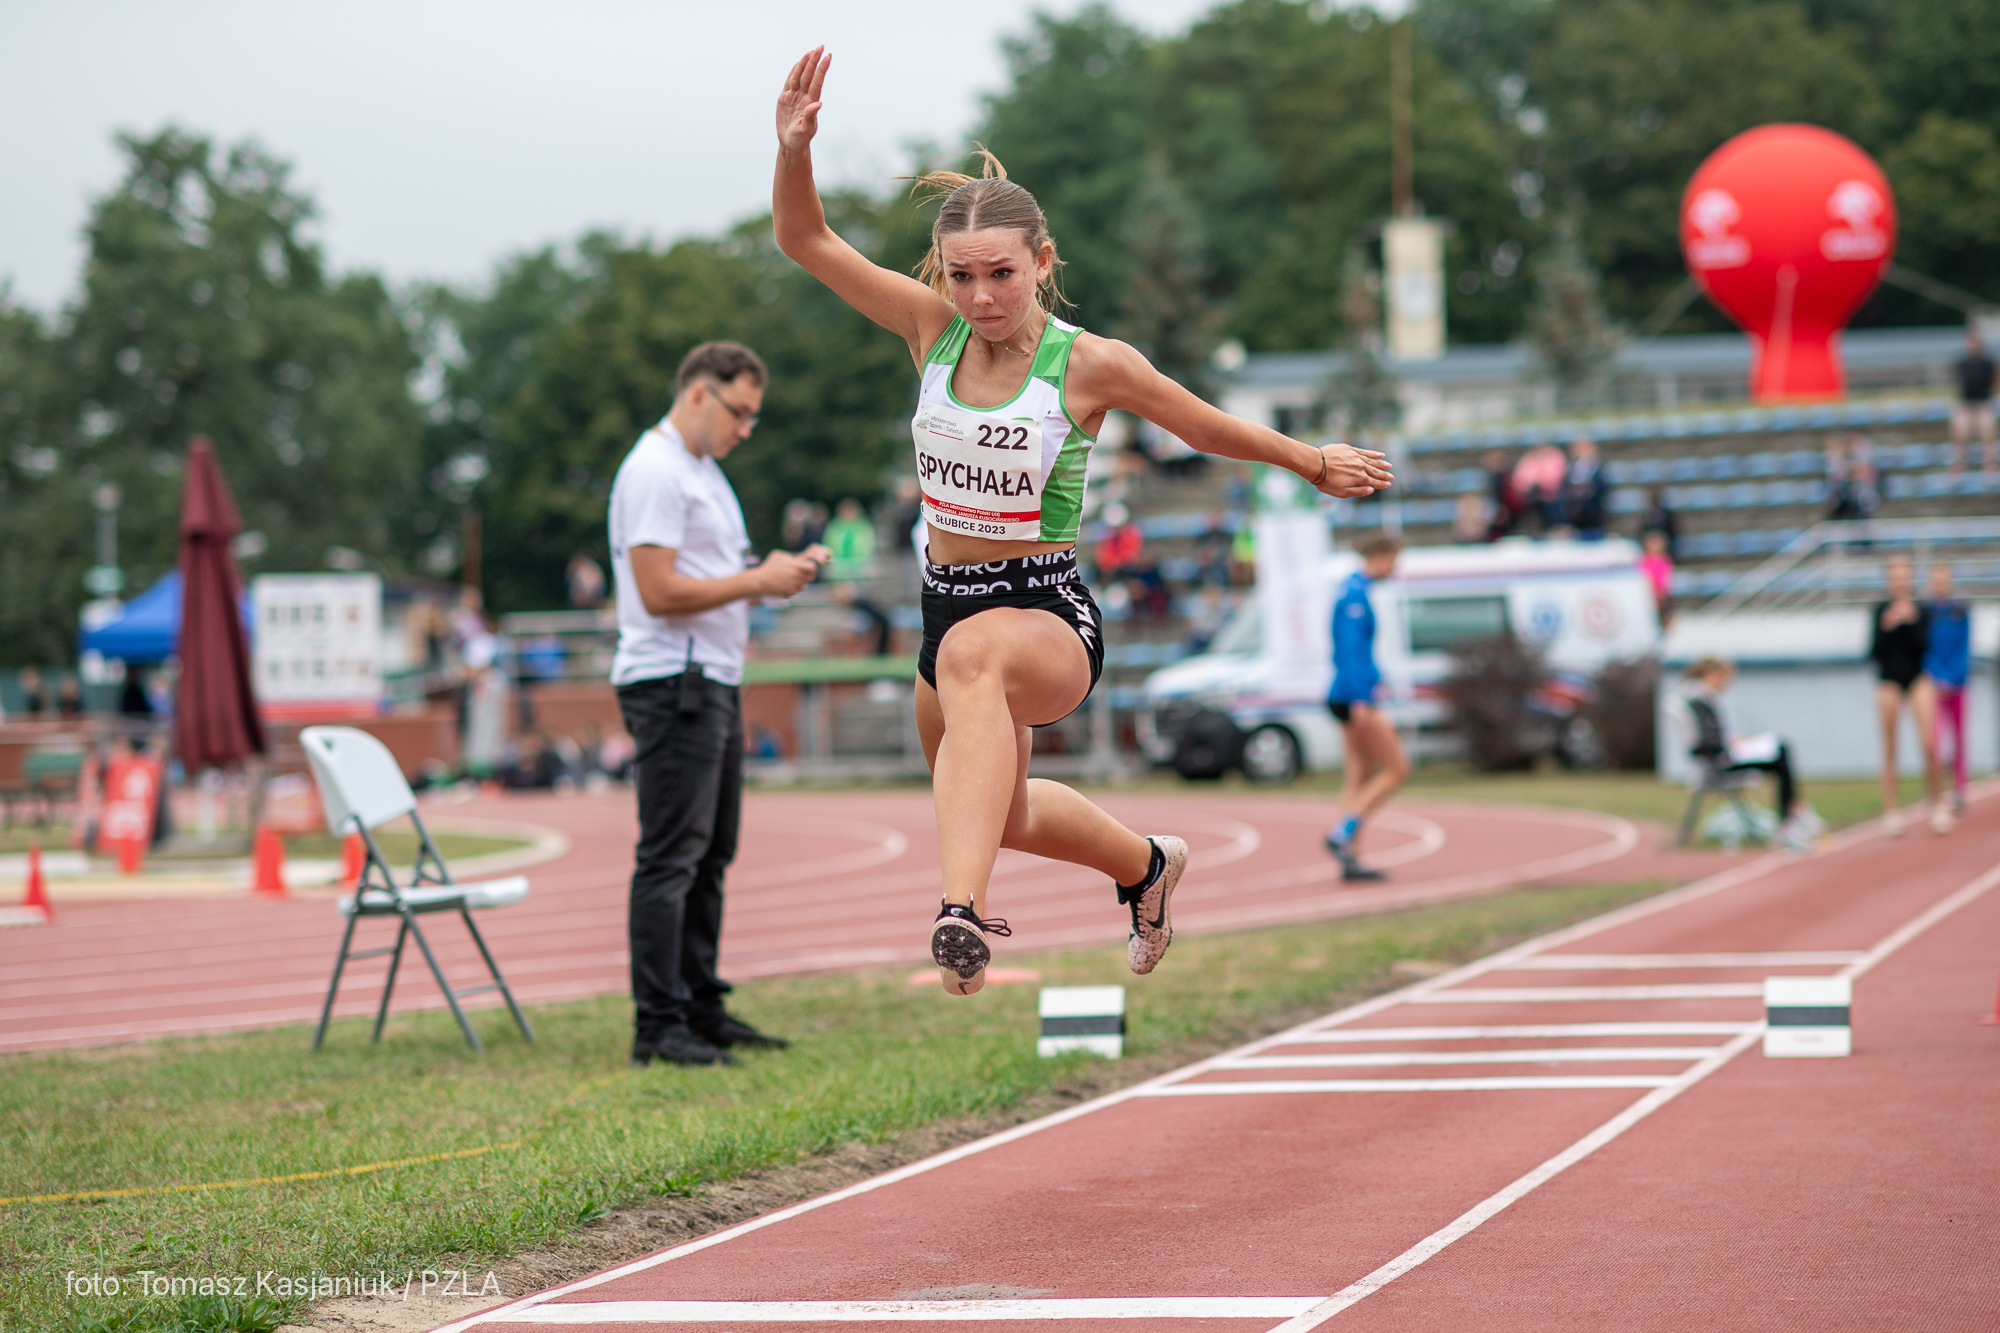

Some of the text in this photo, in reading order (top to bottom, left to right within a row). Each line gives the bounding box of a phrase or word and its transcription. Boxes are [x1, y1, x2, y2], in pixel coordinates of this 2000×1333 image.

[977, 424, 1029, 451] 222
[919, 451, 1035, 497] SPYCHAŁA
[935, 514, 1006, 535] SŁUBICE 2023
